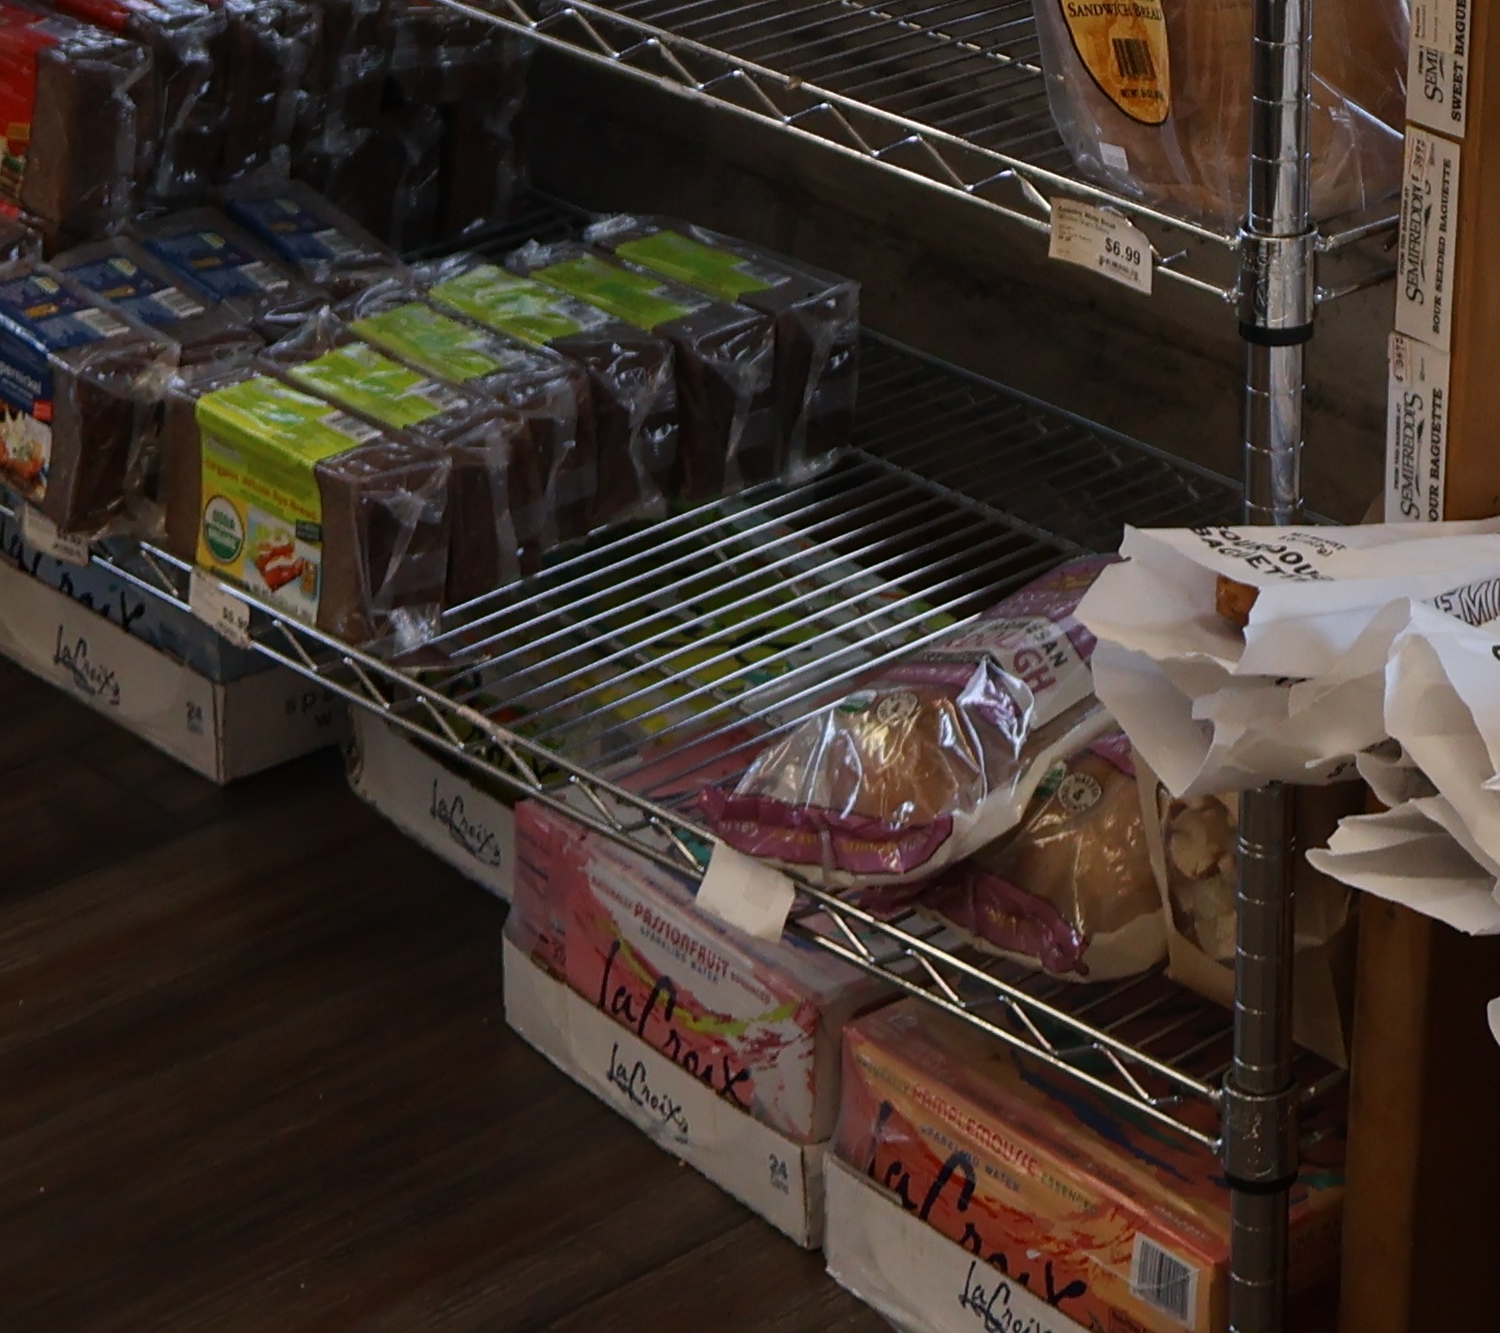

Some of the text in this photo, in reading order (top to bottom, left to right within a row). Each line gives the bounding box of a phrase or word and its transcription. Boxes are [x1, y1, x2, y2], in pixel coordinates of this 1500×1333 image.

[1067, 3, 1163, 21] SANDWICH BREAD
[1450, 52, 1463, 123] SWEET
[1104, 238, 1143, 267] $6.99
[1432, 157, 1454, 335] SOUR SEEDED BAGUETTE
[631, 900, 732, 977] PASSIONFRUIT
[767, 1152, 789, 1179] 24
